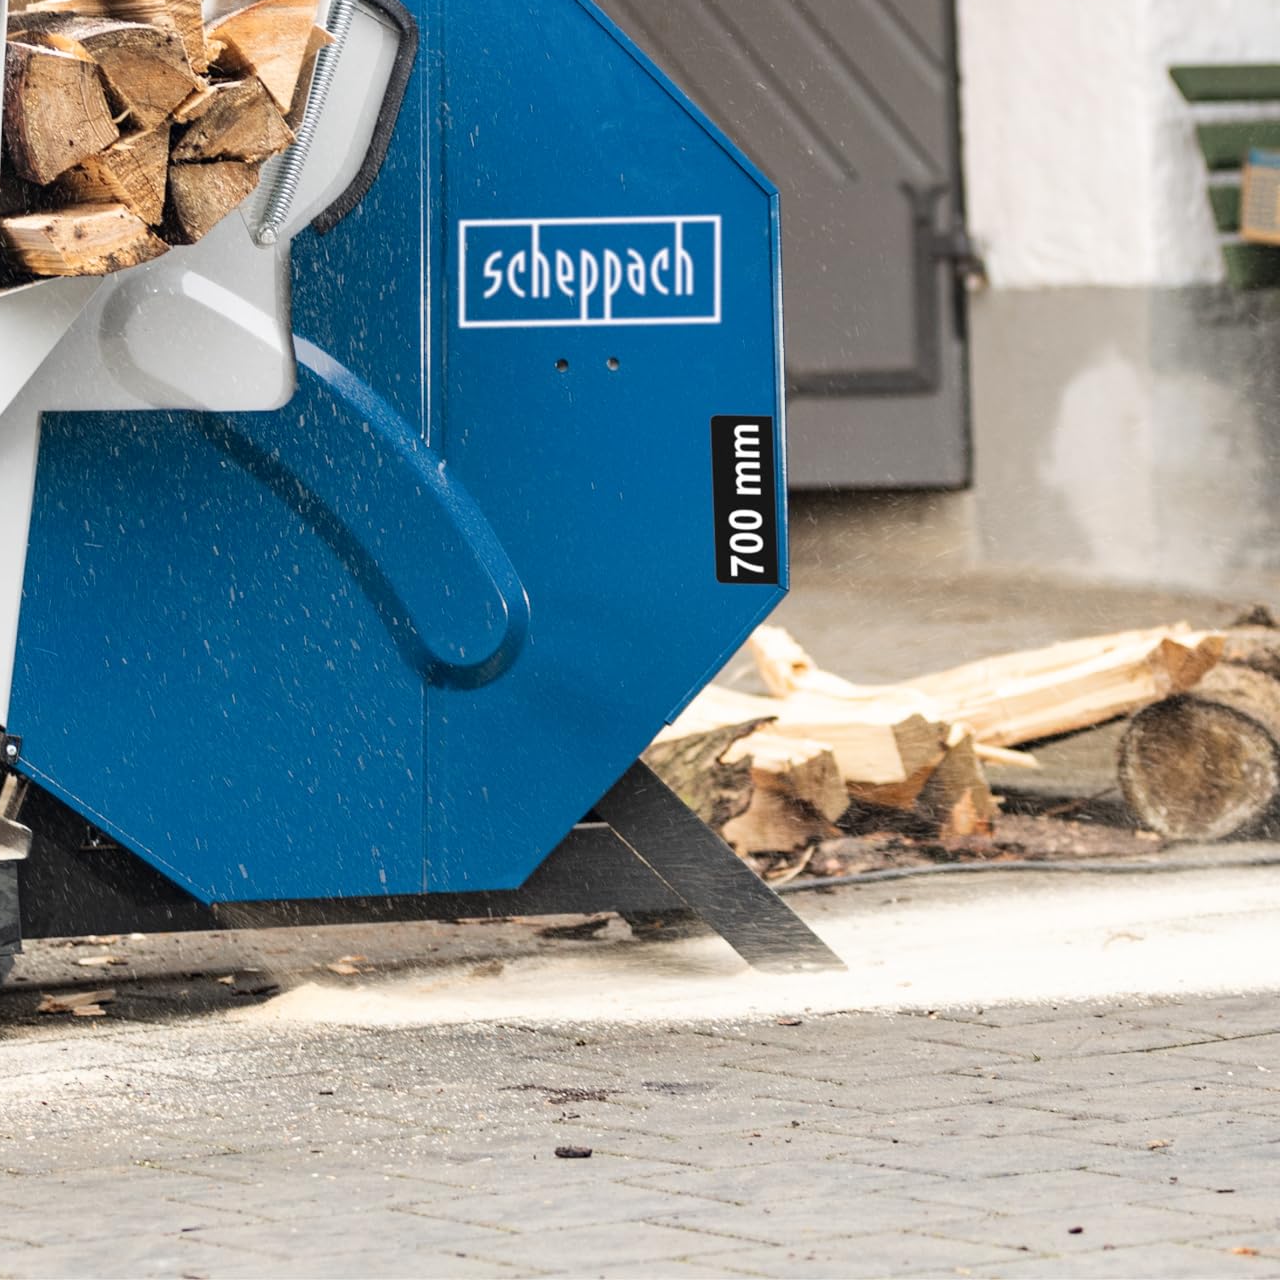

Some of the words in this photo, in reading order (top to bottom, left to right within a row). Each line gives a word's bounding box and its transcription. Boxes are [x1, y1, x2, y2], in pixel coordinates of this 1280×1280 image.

[483, 223, 694, 320] scheppach
[733, 424, 762, 496] mm
[728, 509, 765, 577] 700
